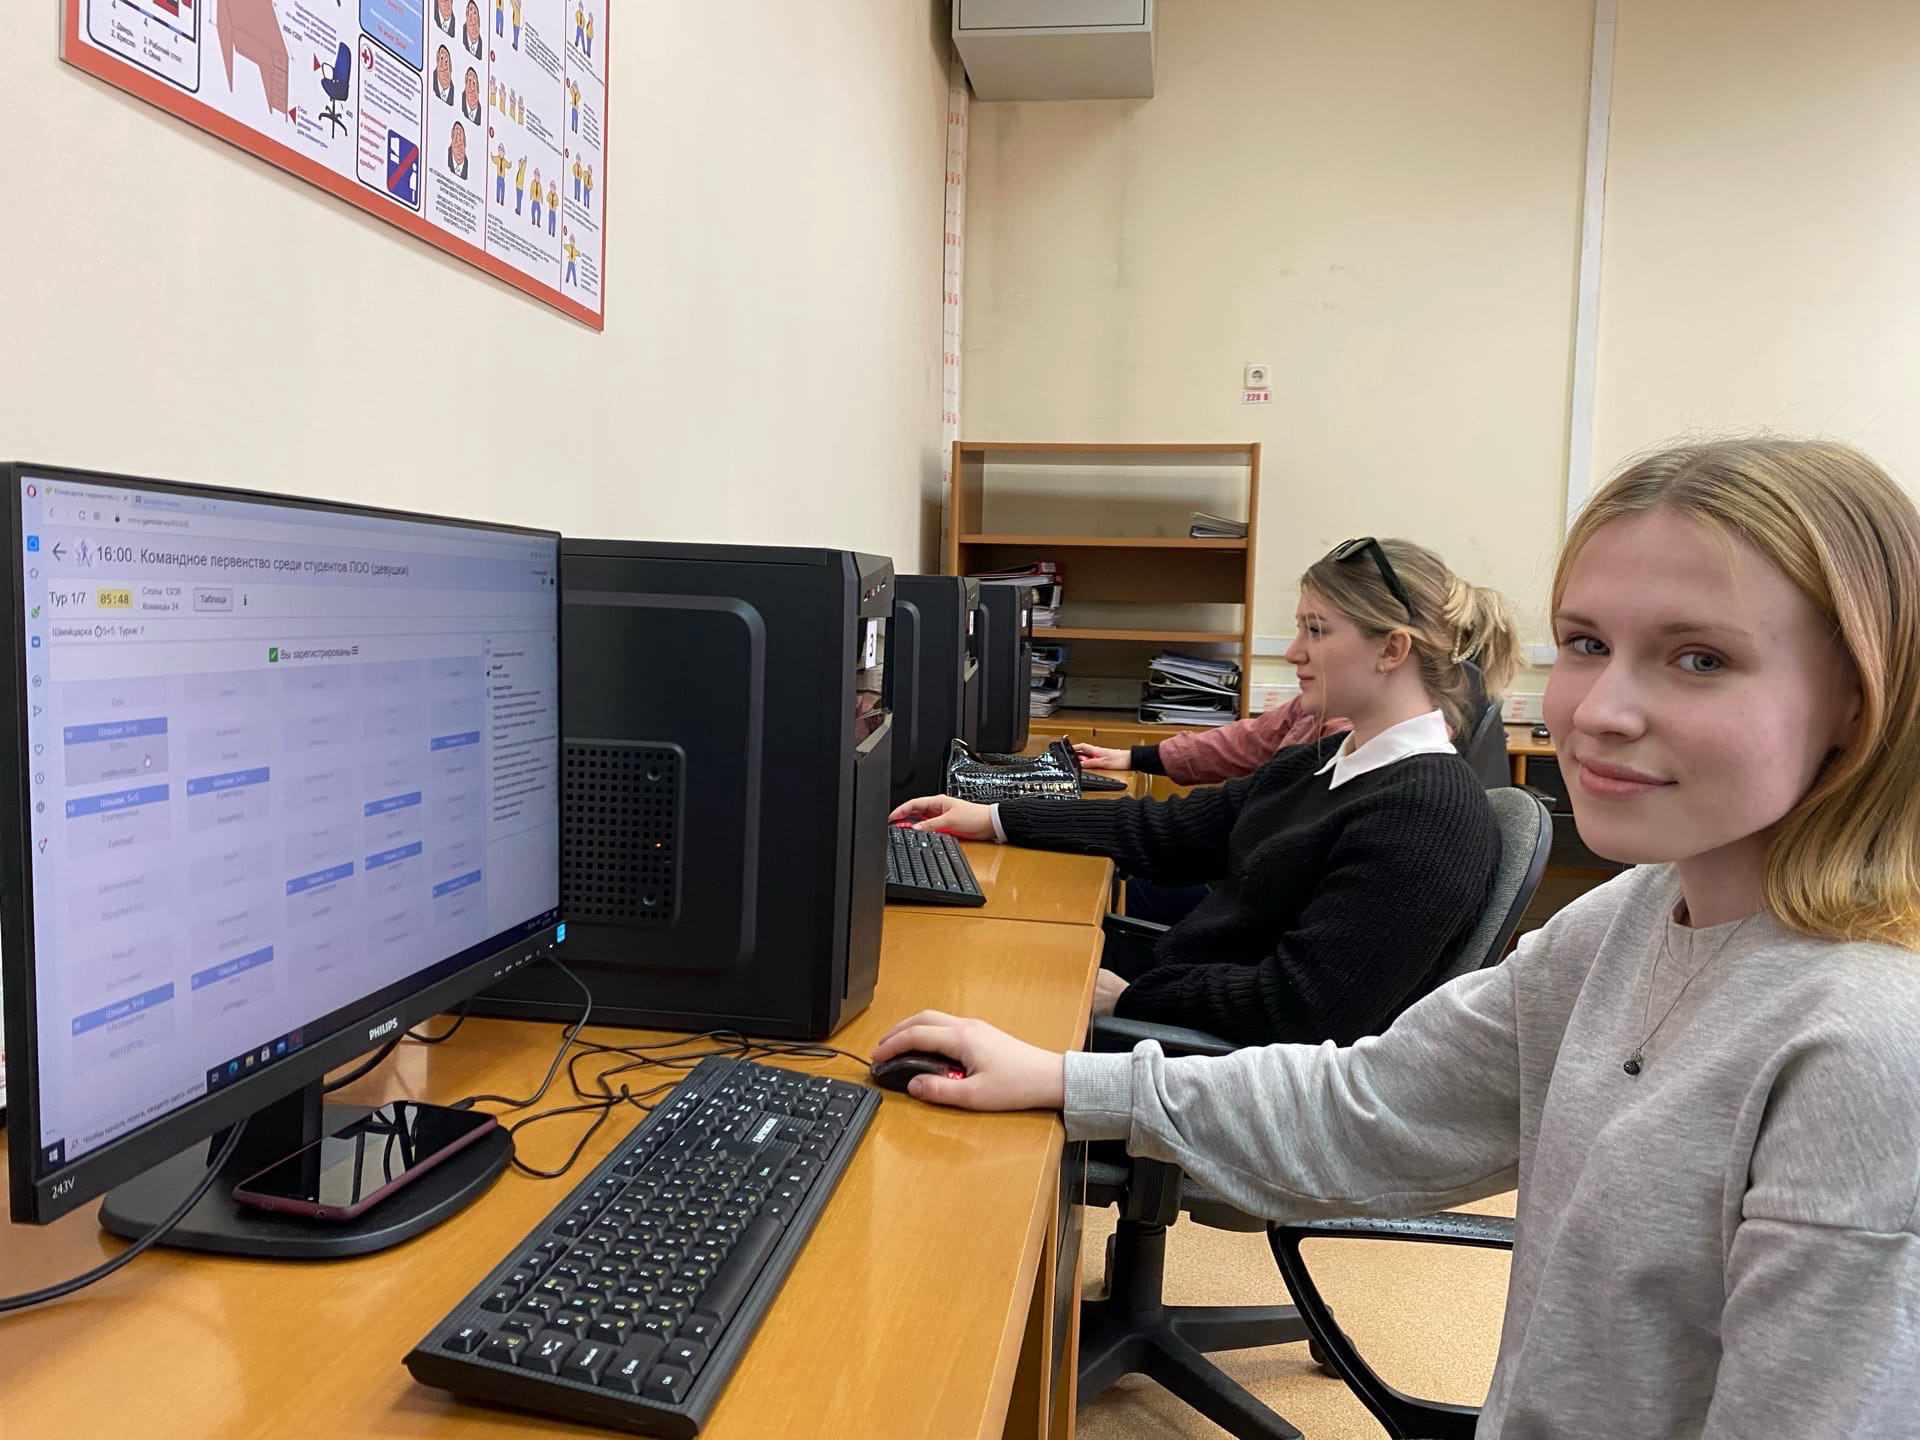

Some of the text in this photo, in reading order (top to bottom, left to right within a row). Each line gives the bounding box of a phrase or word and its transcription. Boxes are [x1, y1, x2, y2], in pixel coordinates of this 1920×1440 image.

[96, 546, 409, 578] 16:00. Командное первенство среди студентов ПОО (девушки)
[50, 592, 86, 606] Тур 1/7
[100, 594, 130, 604] 05:48
[200, 594, 227, 604] Таблица
[52, 627, 92, 638] Швейцарка
[280, 648, 352, 660] Вы зарегистрированы
[368, 1016, 398, 1040] PHILIPS
[52, 1176, 75, 1199] 243V
